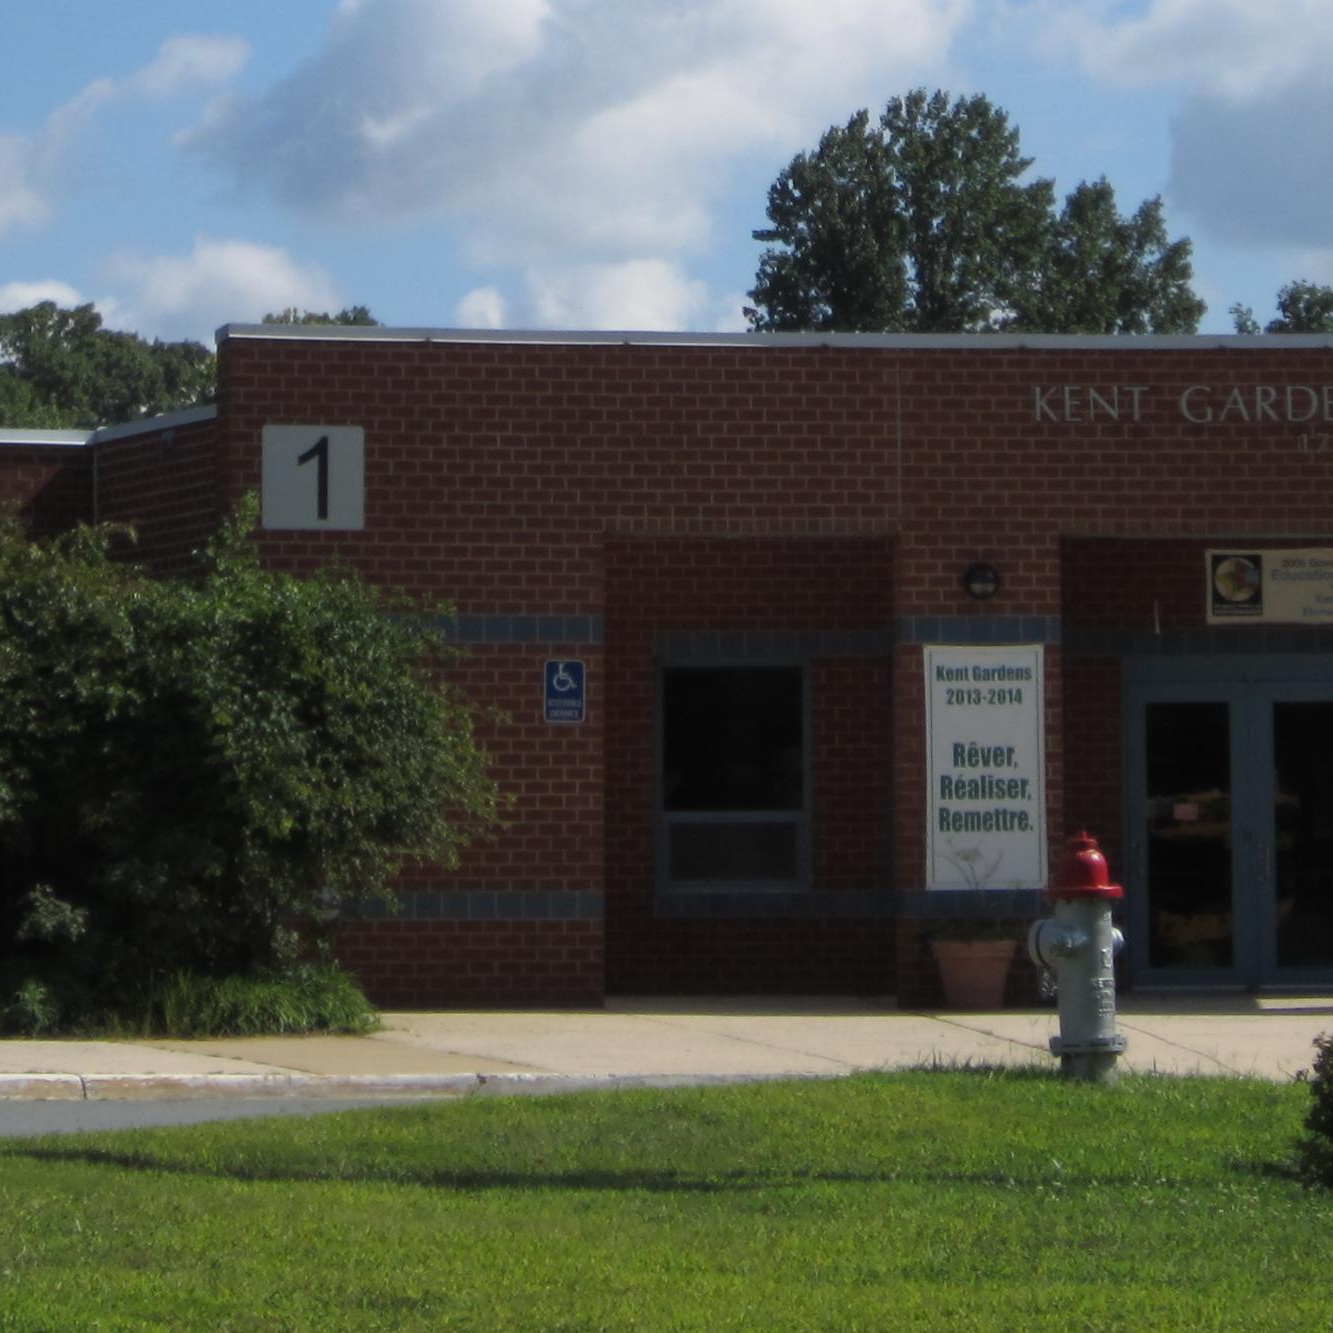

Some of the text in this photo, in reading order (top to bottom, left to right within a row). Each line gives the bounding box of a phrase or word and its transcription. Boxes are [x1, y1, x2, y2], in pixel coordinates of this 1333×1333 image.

[1033, 385, 1148, 422] KENT
[297, 435, 328, 520] 1
[936, 665, 1033, 681] Kent Gardens
[946, 688, 1023, 705] 2013-2014
[953, 741, 1018, 769] Rêver,
[940, 774, 1032, 801] Réaliser,
[939, 807, 1034, 833] Remettre.
